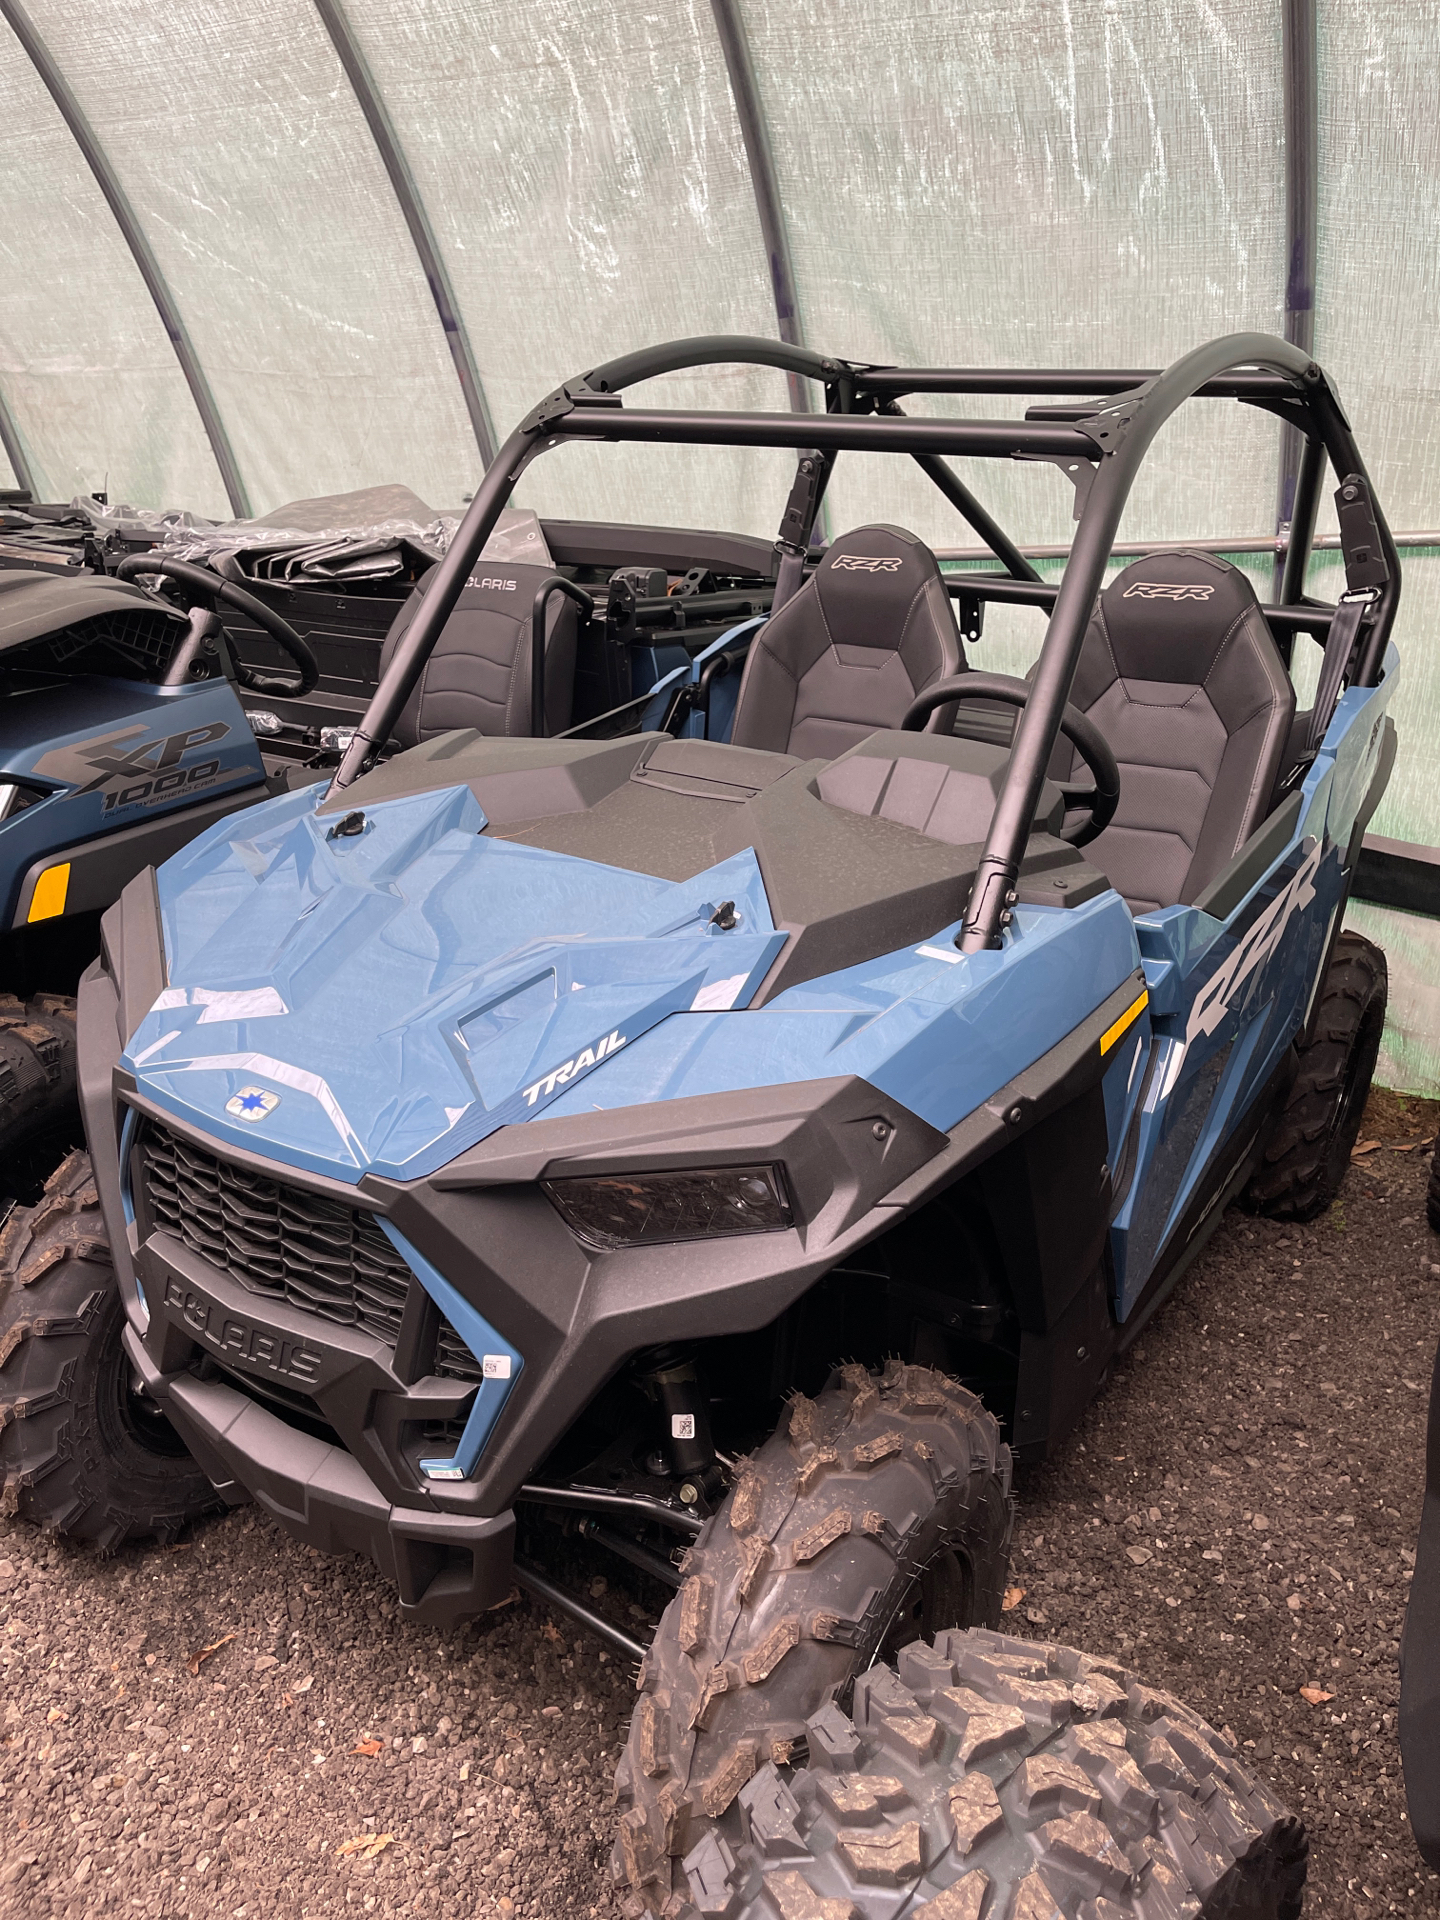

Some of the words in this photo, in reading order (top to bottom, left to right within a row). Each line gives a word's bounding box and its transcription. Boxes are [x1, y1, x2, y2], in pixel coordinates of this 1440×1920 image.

[831, 555, 903, 572] RZR
[1123, 582, 1215, 600] RZR
[69, 721, 231, 797] XP
[104, 760, 220, 811] 1000
[135, 784, 192, 809] OVERHEAD
[193, 777, 217, 790] CAM
[1186, 838, 1322, 1043] RZR
[522, 1029, 627, 1107] TRAIL
[164, 1275, 323, 1384] POLARIS
